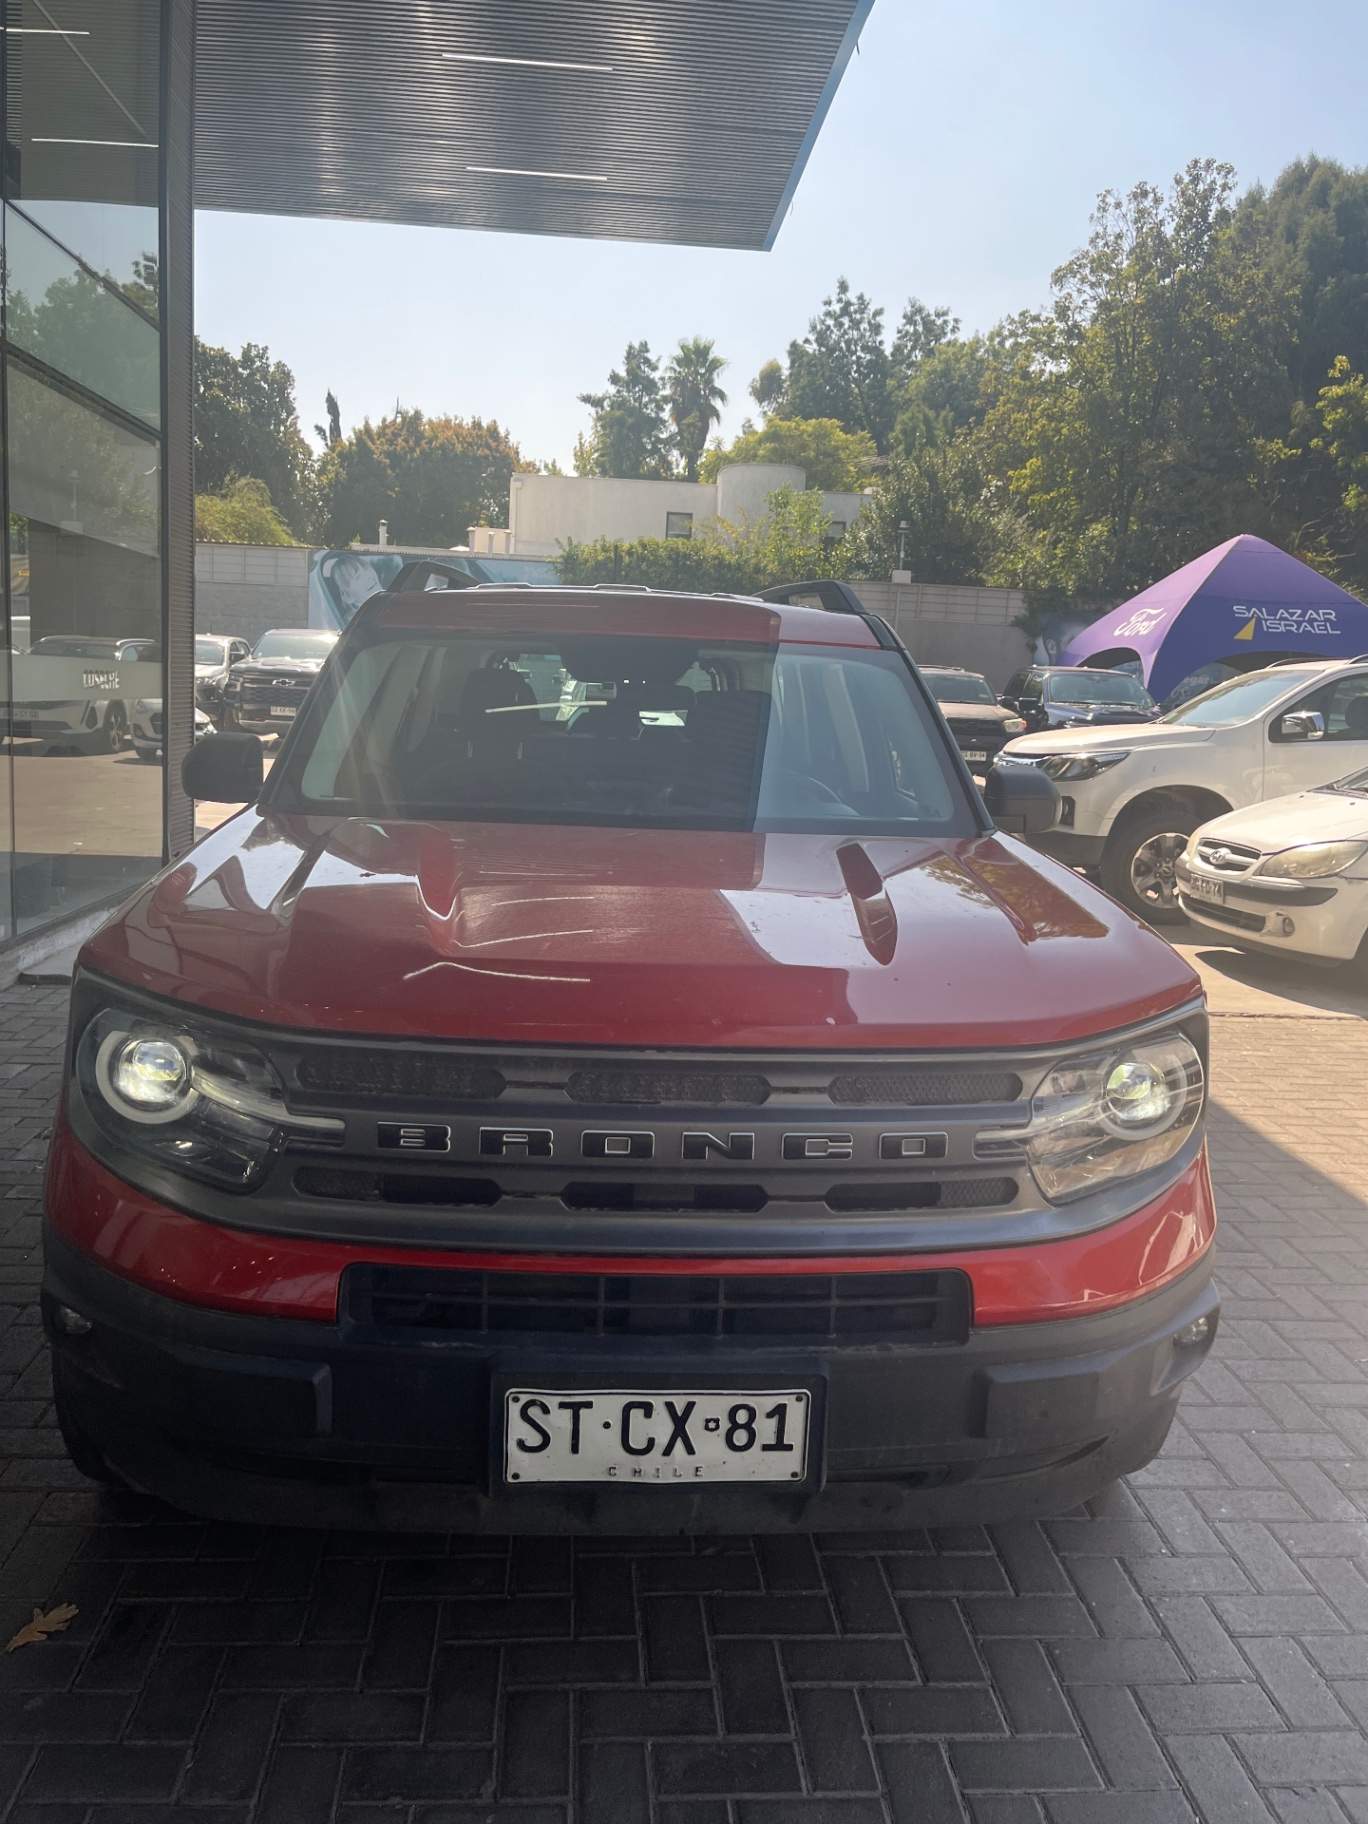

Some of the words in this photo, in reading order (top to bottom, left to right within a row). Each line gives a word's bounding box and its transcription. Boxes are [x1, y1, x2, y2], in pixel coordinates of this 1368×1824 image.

[1233, 605, 1336, 621] SALAZAR
[1113, 607, 1167, 637] Ford
[1262, 620, 1341, 634] ISRAEL
[377, 1121, 949, 1160] BRONCO
[608, 1465, 704, 1478] CHILE
